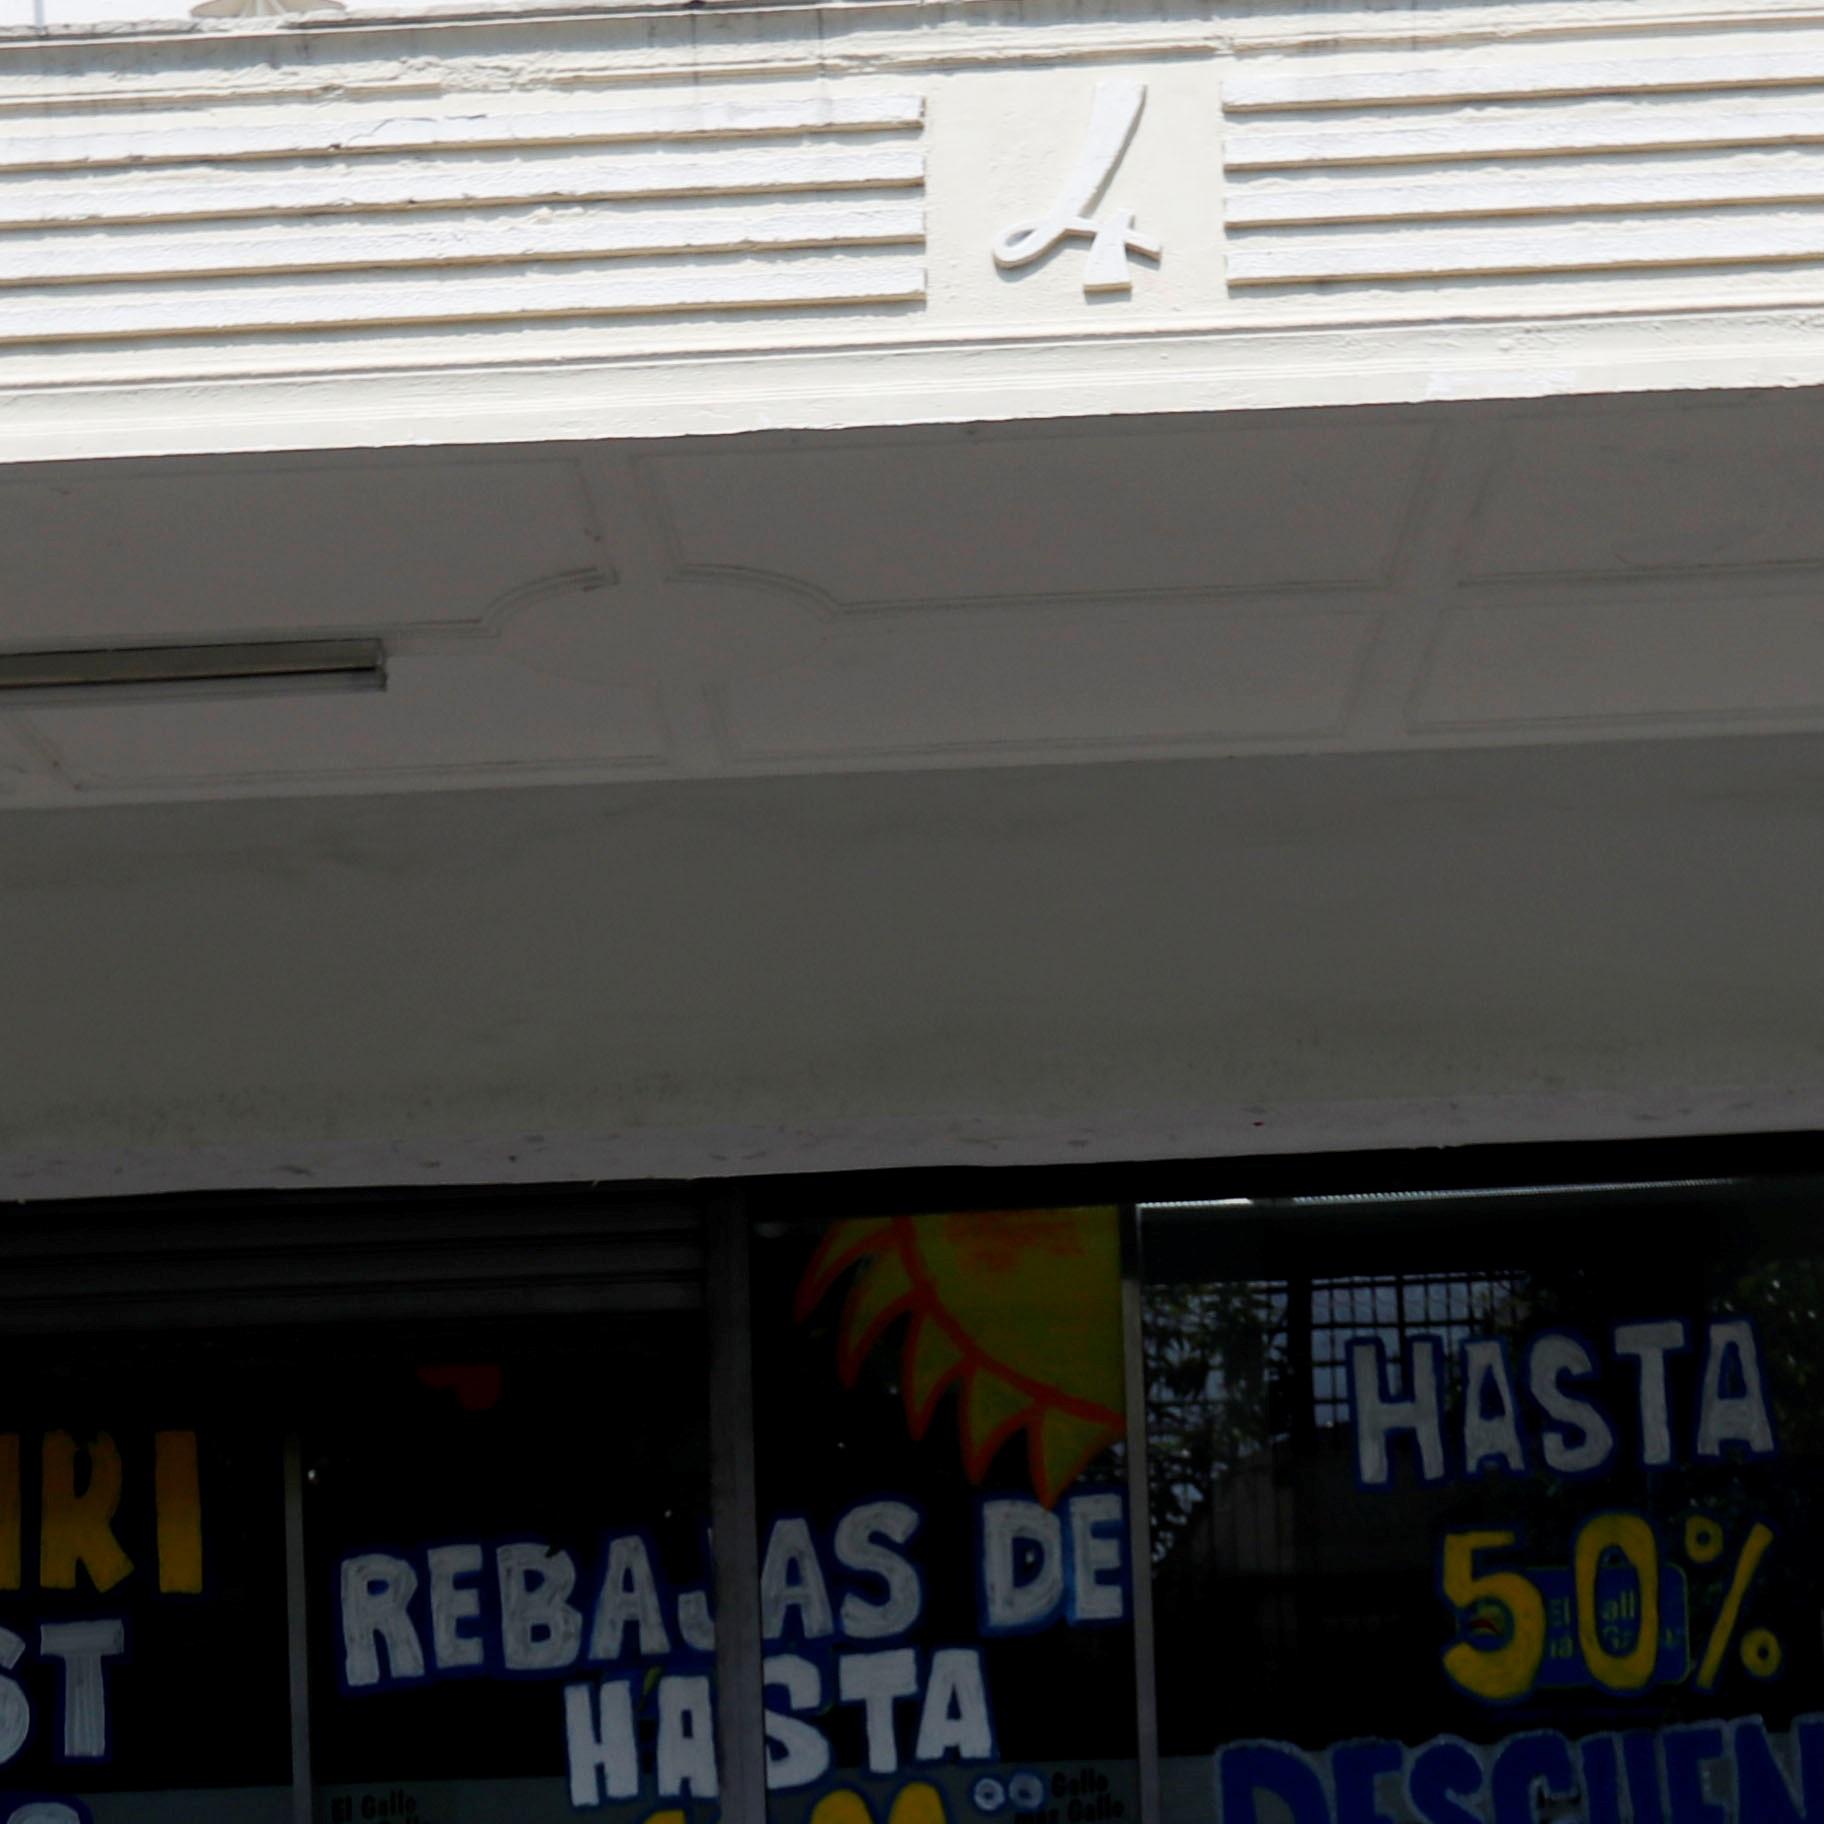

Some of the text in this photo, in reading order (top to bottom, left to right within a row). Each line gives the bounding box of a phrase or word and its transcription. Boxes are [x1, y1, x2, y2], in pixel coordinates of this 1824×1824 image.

[1349, 1317, 1777, 1488] HASTA
[980, 1492, 1125, 1631] DE
[1439, 1510, 1784, 1703] 50%
[361, 1788, 417, 1820] Gallo
[563, 1648, 997, 1808] HASTA
